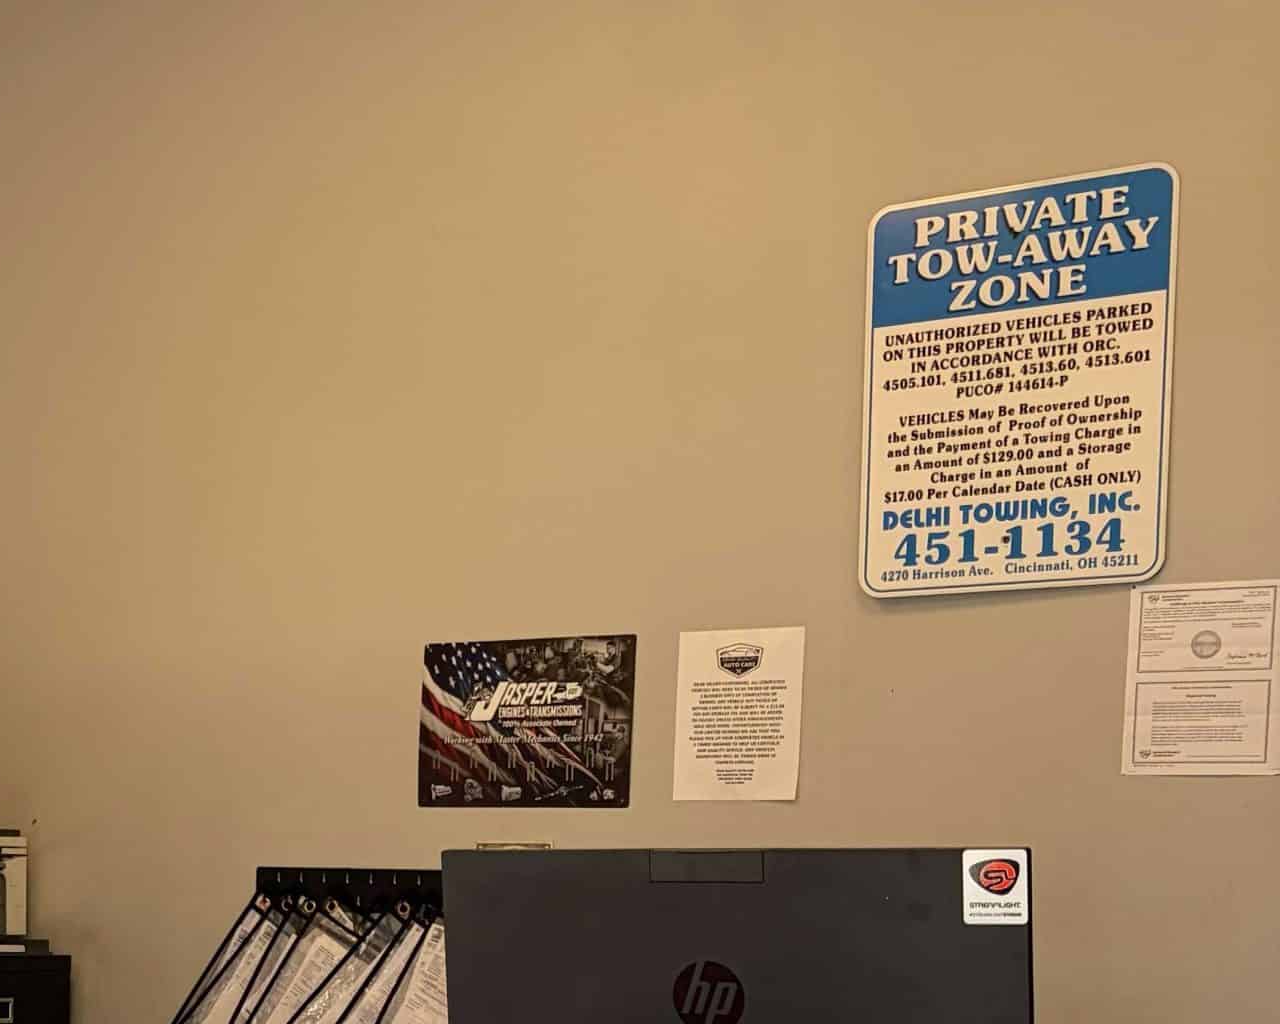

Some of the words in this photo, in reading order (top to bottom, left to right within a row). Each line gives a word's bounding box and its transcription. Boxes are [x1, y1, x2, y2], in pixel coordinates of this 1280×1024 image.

[914, 185, 1130, 248] PRIVATE
[887, 216, 1160, 284] TOW-AWAY
[947, 263, 1087, 311] ZONE
[883, 349, 904, 362] ON
[908, 344, 941, 360] THIS
[945, 334, 1025, 354] PROPERTY
[1029, 329, 1067, 345] WILL
[1071, 326, 1091, 339] BE
[1095, 318, 1154, 336] TOWED
[885, 322, 1001, 347] UNAUTHORIZED
[1006, 311, 1081, 332] VEHICLES
[1086, 302, 1152, 321] PARKED
[883, 374, 946, 392] 4505.101,
[950, 366, 1015, 384] 4511.681,
[1019, 358, 1081, 376] 4513.60,
[1084, 349, 1152, 368] 4513.601
[911, 361, 926, 373] IN
[930, 348, 1033, 371] ACCORDANCE
[1037, 343, 1078, 358] WITH
[1082, 338, 1121, 353] ORC.
[956, 383, 1004, 399] PUCO#
[1008, 375, 1069, 393] 144614-P
[887, 432, 907, 443] the
[911, 425, 984, 441] Submission
[988, 421, 1002, 433] of
[1009, 416, 1047, 431] Proof
[1049, 414, 1064, 427] of
[1067, 408, 1143, 425] Ownership
[899, 409, 965, 427] VEHICLES
[968, 408, 995, 421] May
[998, 405, 1015, 417] Be
[1019, 396, 1090, 415] Recovered
[1094, 394, 1130, 409] Upon
[887, 446, 910, 459] and
[914, 444, 933, 456] the
[937, 438, 992, 454] Payment
[995, 435, 1009, 448] of
[1012, 438, 1020, 446] a
[1023, 431, 1070, 444] Towing
[1074, 426, 1124, 440] Charge
[1128, 423, 1142, 434] in
[895, 462, 910, 472] an
[914, 456, 963, 471] Amount
[966, 453, 980, 466] of
[983, 448, 1034, 465] $129.00
[1038, 445, 1063, 459] and
[1066, 447, 1074, 456] a
[1078, 442, 1132, 455] Storage
[884, 488, 924, 504] $17.00
[927, 486, 949, 500] Per
[952, 481, 1012, 498] Calendar
[1015, 479, 1046, 493] Date
[1050, 473, 1093, 492] (CASH
[1097, 469, 1142, 486] ONLY)
[930, 470, 976, 484] Charge
[980, 469, 992, 479] in
[996, 467, 1012, 477] an
[1016, 461, 1067, 476] Amount
[1076, 458, 1090, 470] of
[882, 506, 951, 532] DELHI
[960, 496, 1078, 525] TOWING,
[1089, 491, 1141, 514] INC.
[894, 518, 1126, 568] 451-1134
[881, 570, 909, 583] 4270
[912, 566, 966, 580] Harrison
[970, 564, 994, 577] Ave.
[1005, 559, 1073, 575] Cincinnati,
[1078, 557, 1098, 570] OH
[1102, 554, 1139, 568] 45211
[469, 681, 558, 721] JASPER
[499, 705, 526, 719] ENGINES
[530, 704, 583, 719] TRANSMISSIONS
